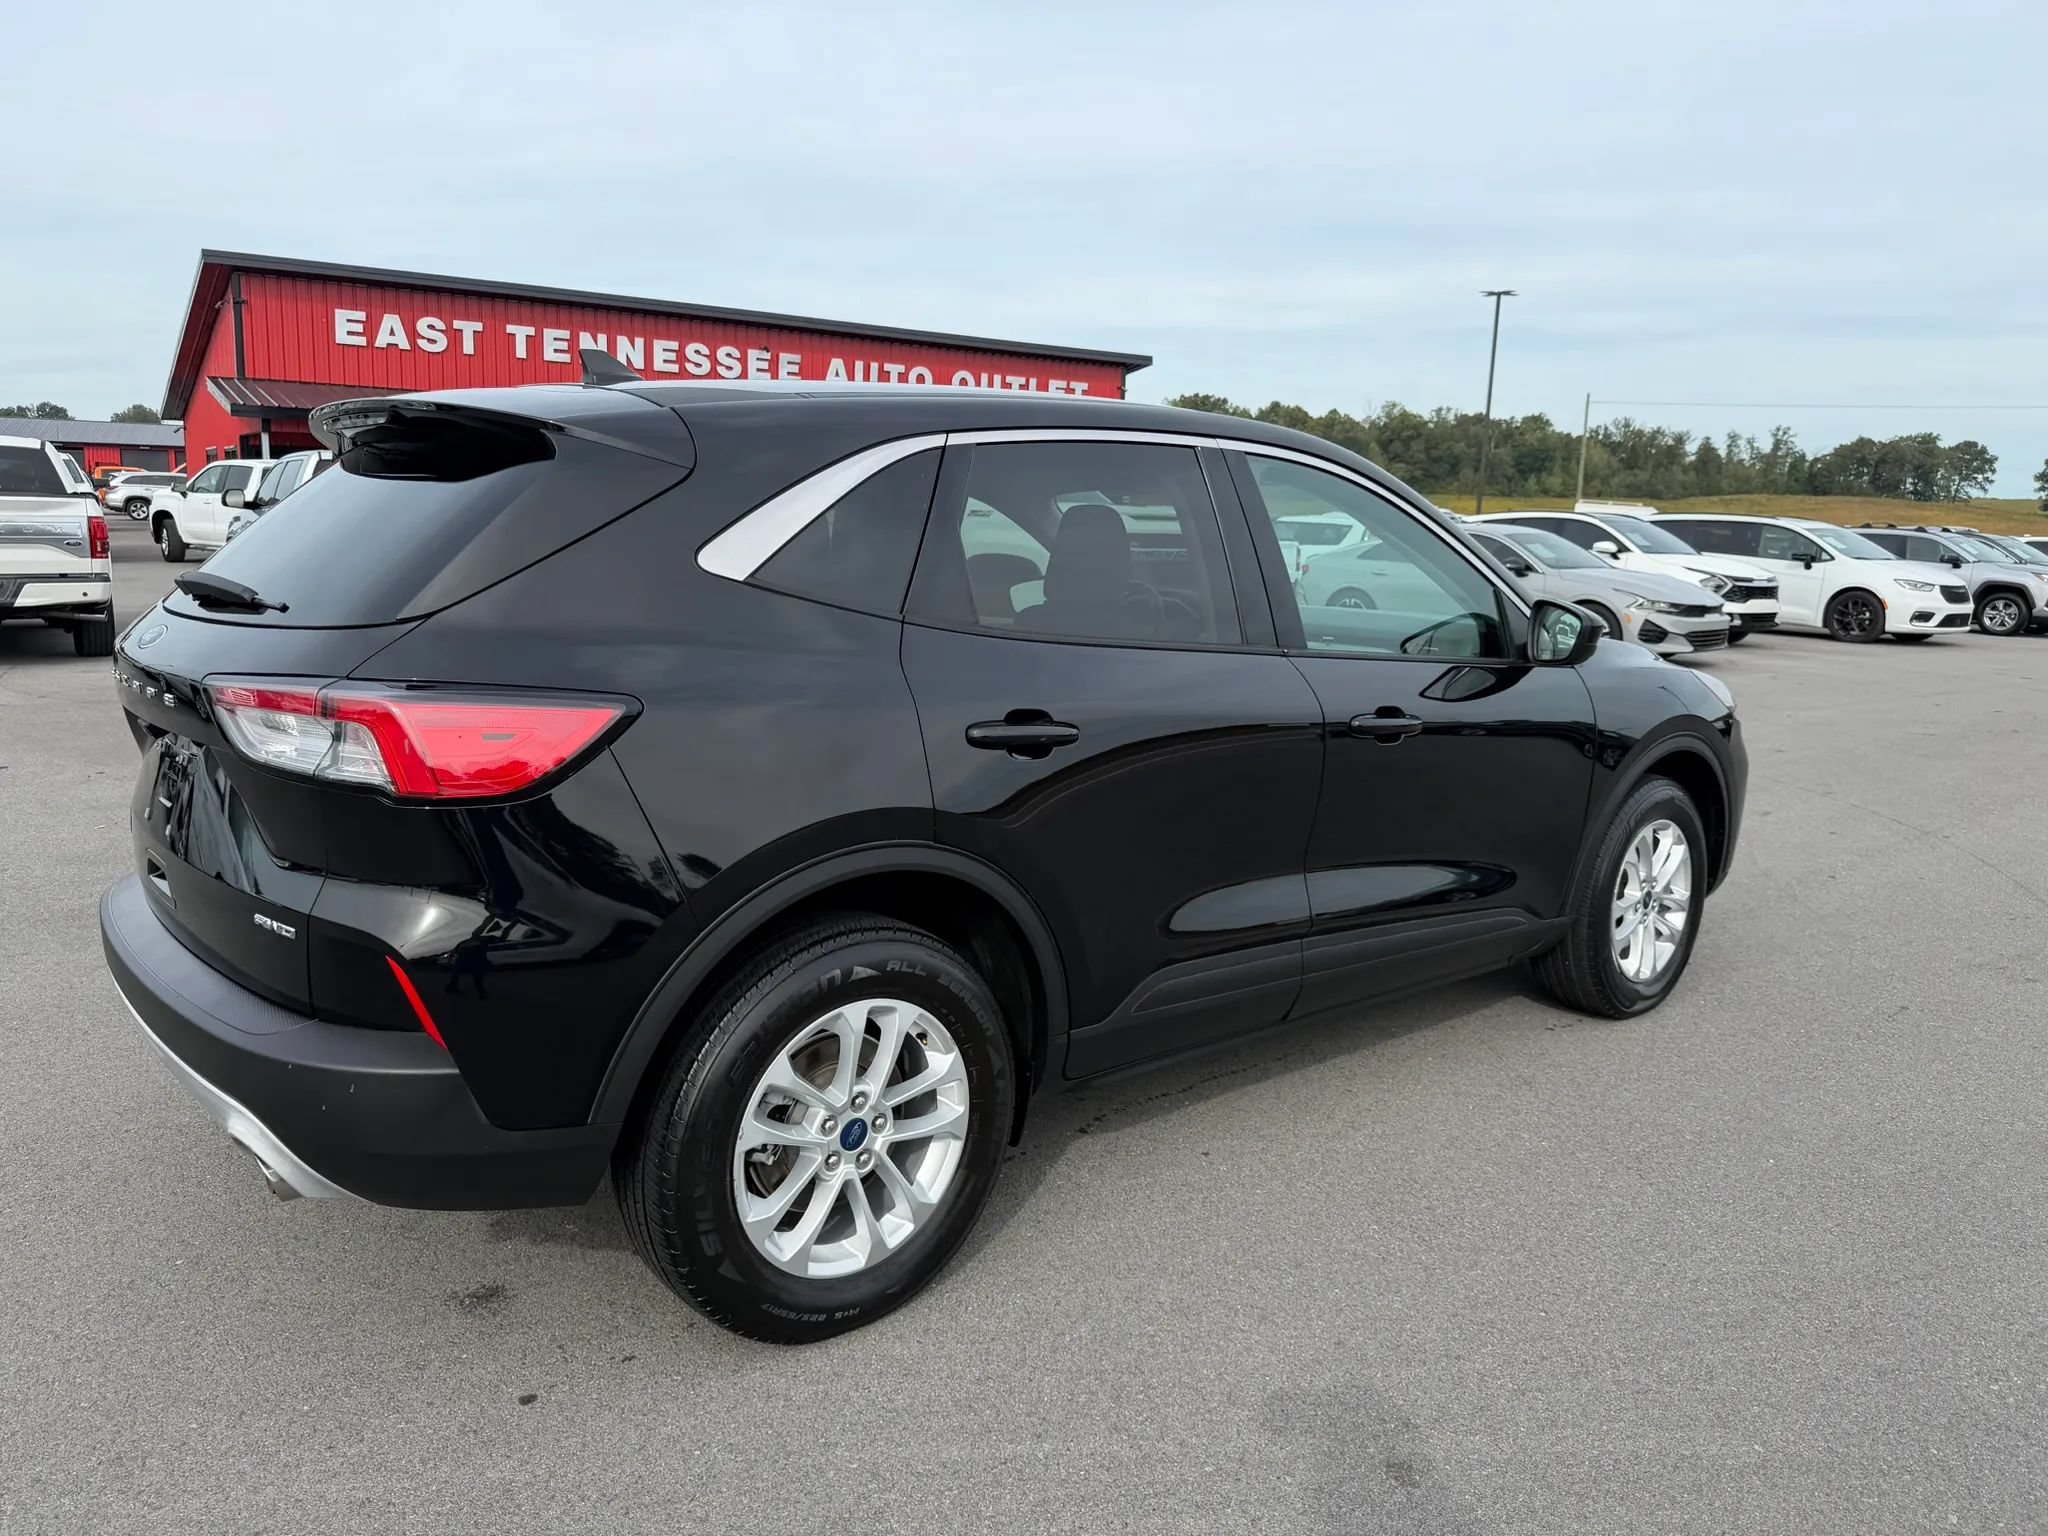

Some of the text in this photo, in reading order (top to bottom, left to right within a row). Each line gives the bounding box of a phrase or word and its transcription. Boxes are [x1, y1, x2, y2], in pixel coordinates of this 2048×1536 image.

[334, 308, 483, 356] EAST
[506, 324, 802, 380] TENNESSEE
[825, 358, 933, 385] AUTO
